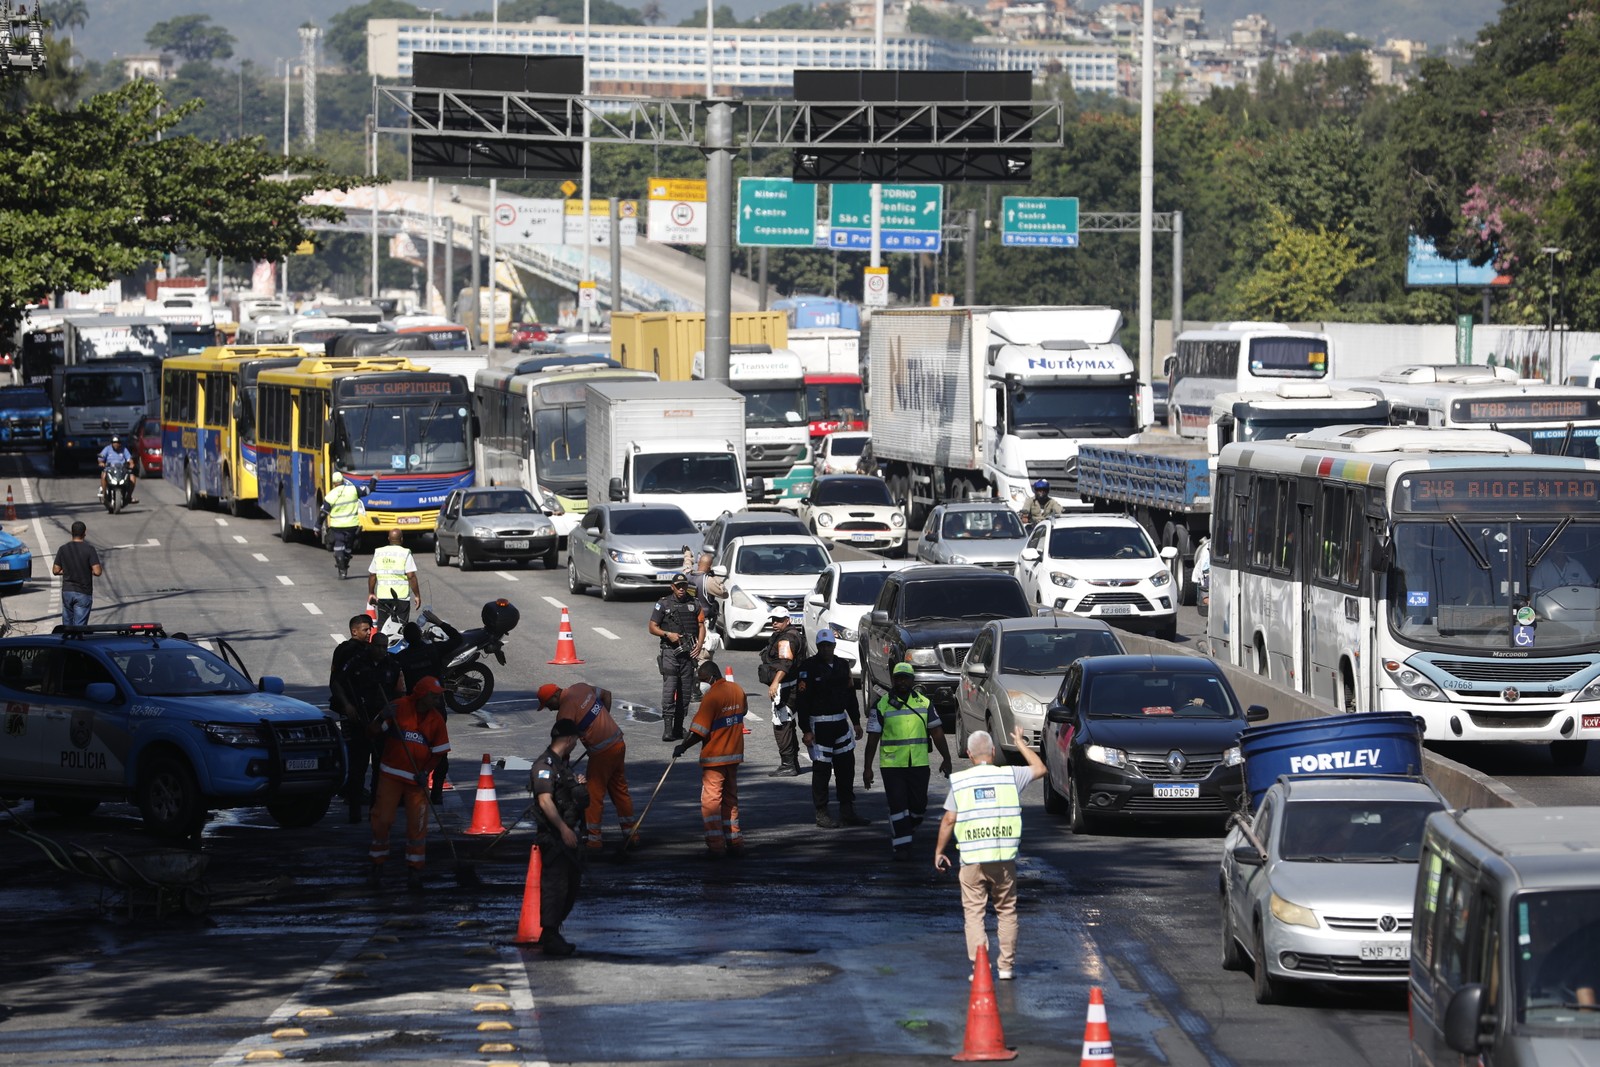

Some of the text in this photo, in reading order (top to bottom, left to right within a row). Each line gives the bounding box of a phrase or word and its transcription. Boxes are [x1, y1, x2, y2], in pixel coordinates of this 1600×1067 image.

[754, 190, 788, 199] Niterói
[868, 189, 917, 199] TORNO
[754, 208, 787, 217] Centro
[880, 203, 917, 212] enfica
[839, 214, 916, 226] São Cstóvão
[1017, 212, 1046, 220] Centro
[754, 226, 810, 236] Copacabana
[1017, 222, 1067, 231] Copacabana
[903, 237, 922, 246] Rio
[741, 363, 790, 371] Transverde
[1028, 357, 1115, 373] NUTRYMAX
[383, 381, 451, 394] GUAPIMIRIM
[1509, 405, 1526, 417] via
[1530, 401, 1582, 417] CHATUBA
[1419, 480, 1596, 498] 348 RIOCENTRO
[1409, 596, 1427, 606] 4,30
[1443, 679, 1473, 690] C47668
[129, 704, 165, 717] 52-3697
[405, 731, 419, 739] RIO
[60, 748, 107, 770] POLÍCIA
[1290, 748, 1381, 774] FORTLEV
[984, 788, 996, 798] RIO
[1361, 946, 1384, 958] ENB
